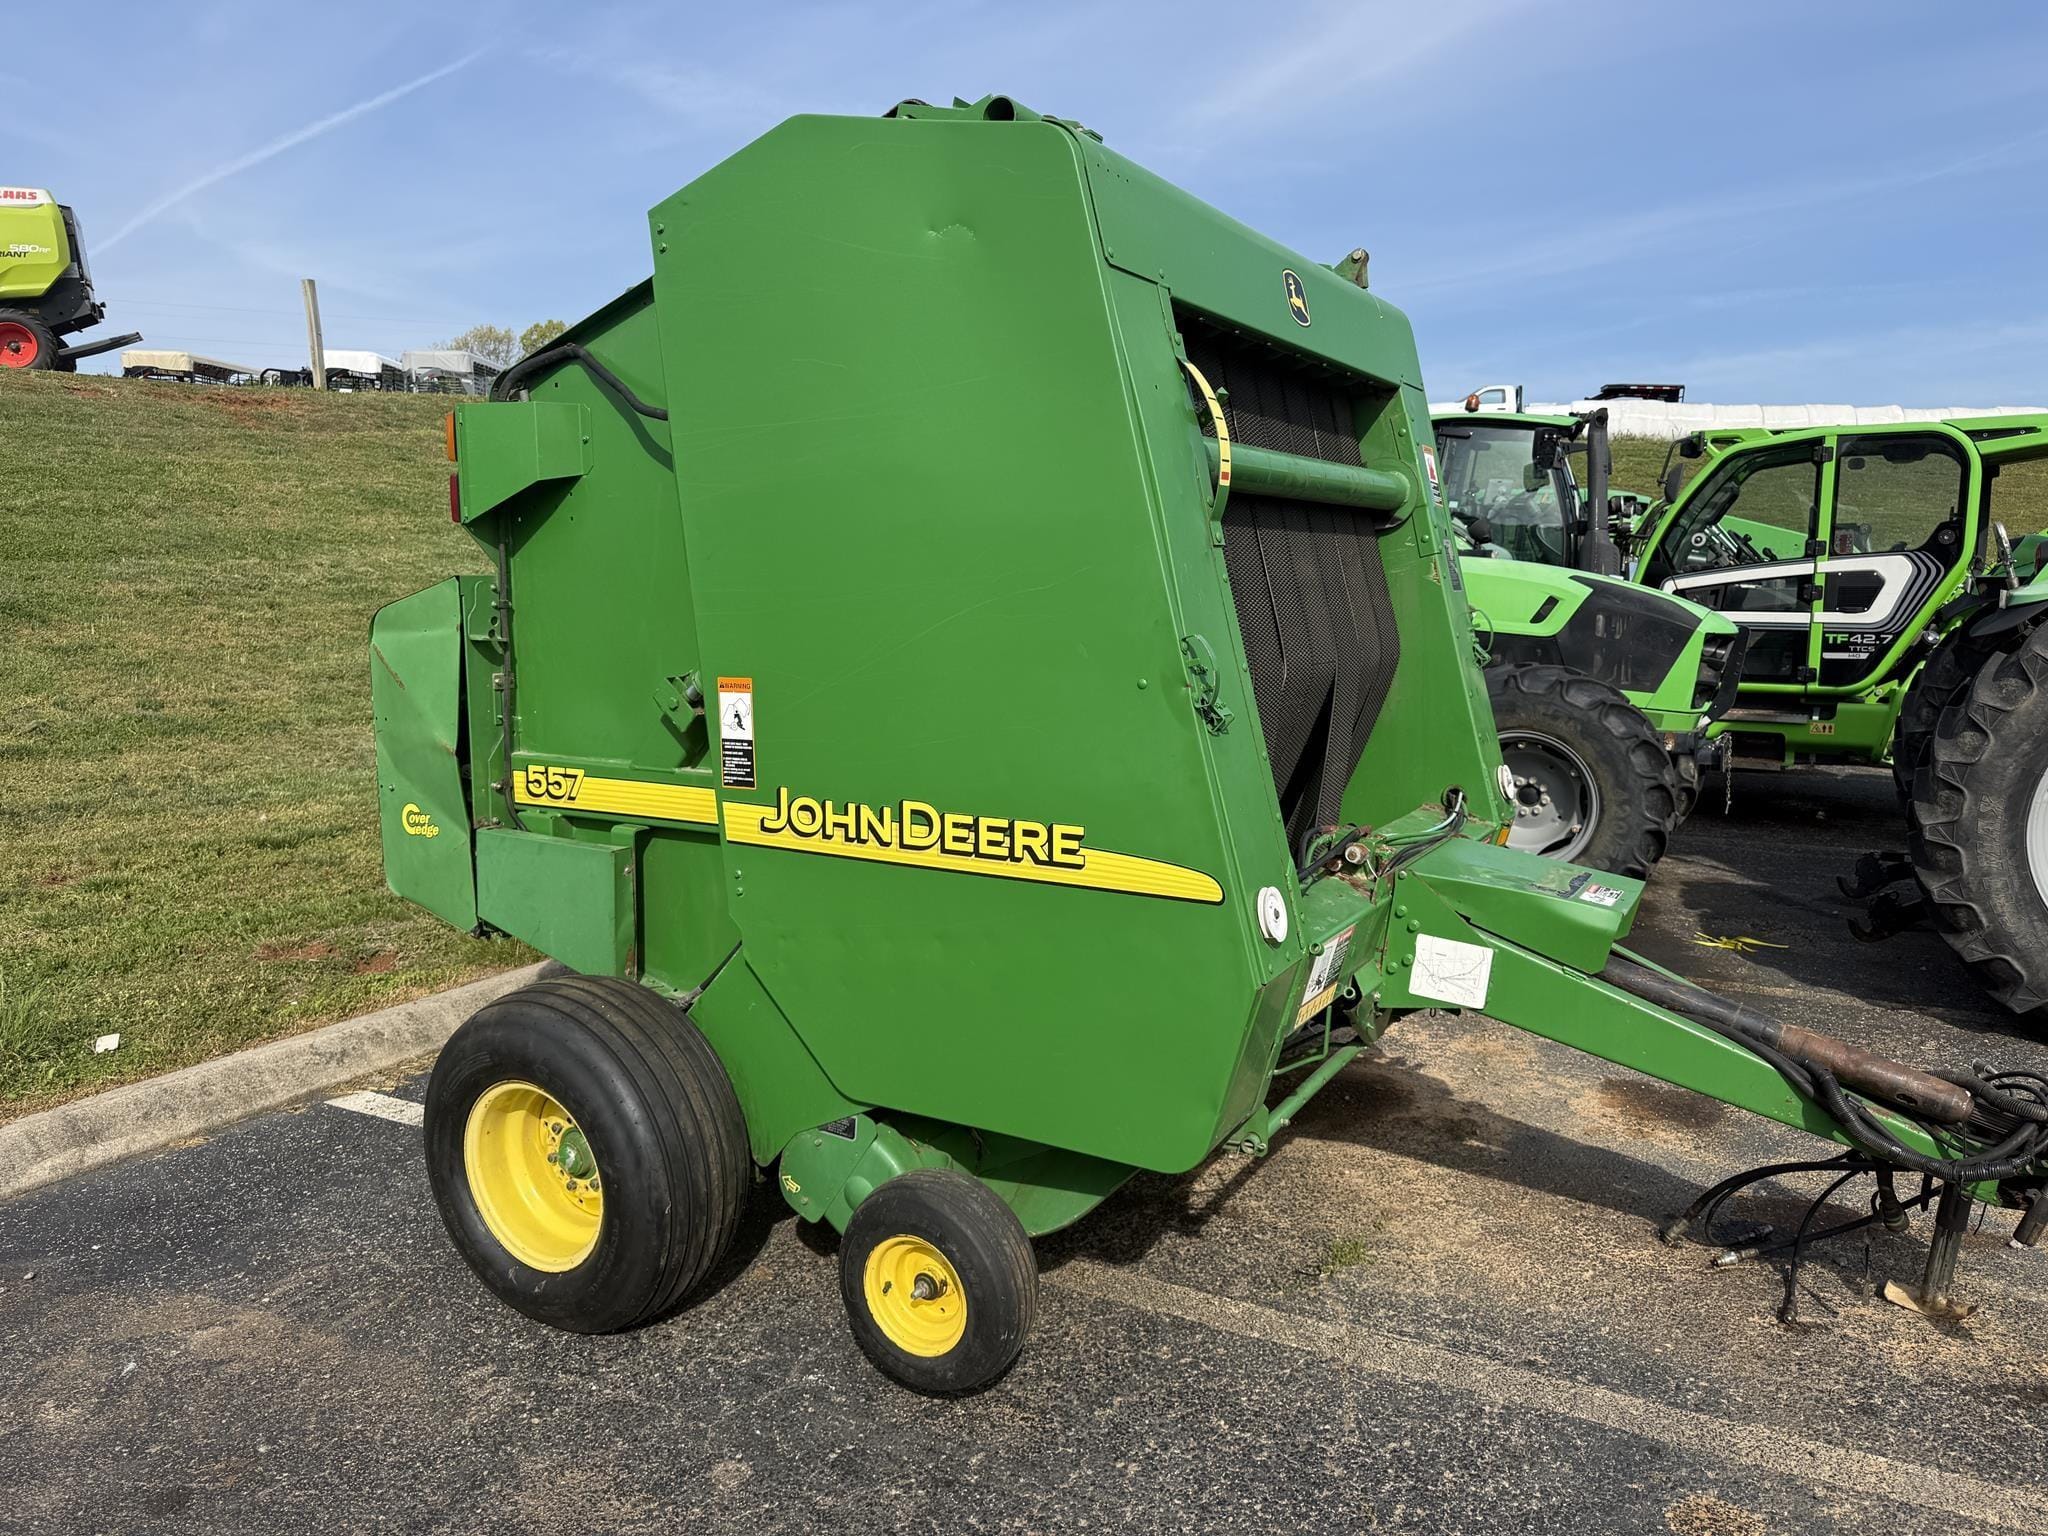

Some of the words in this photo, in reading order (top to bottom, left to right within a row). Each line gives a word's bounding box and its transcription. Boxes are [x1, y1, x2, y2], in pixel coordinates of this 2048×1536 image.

[0, 190, 37, 200] AAS
[9, 244, 39, 253] 580
[1825, 633, 1894, 644] TF42.7
[526, 764, 585, 801] 557
[760, 786, 892, 848] JOHN
[899, 799, 1086, 868] DEERE
